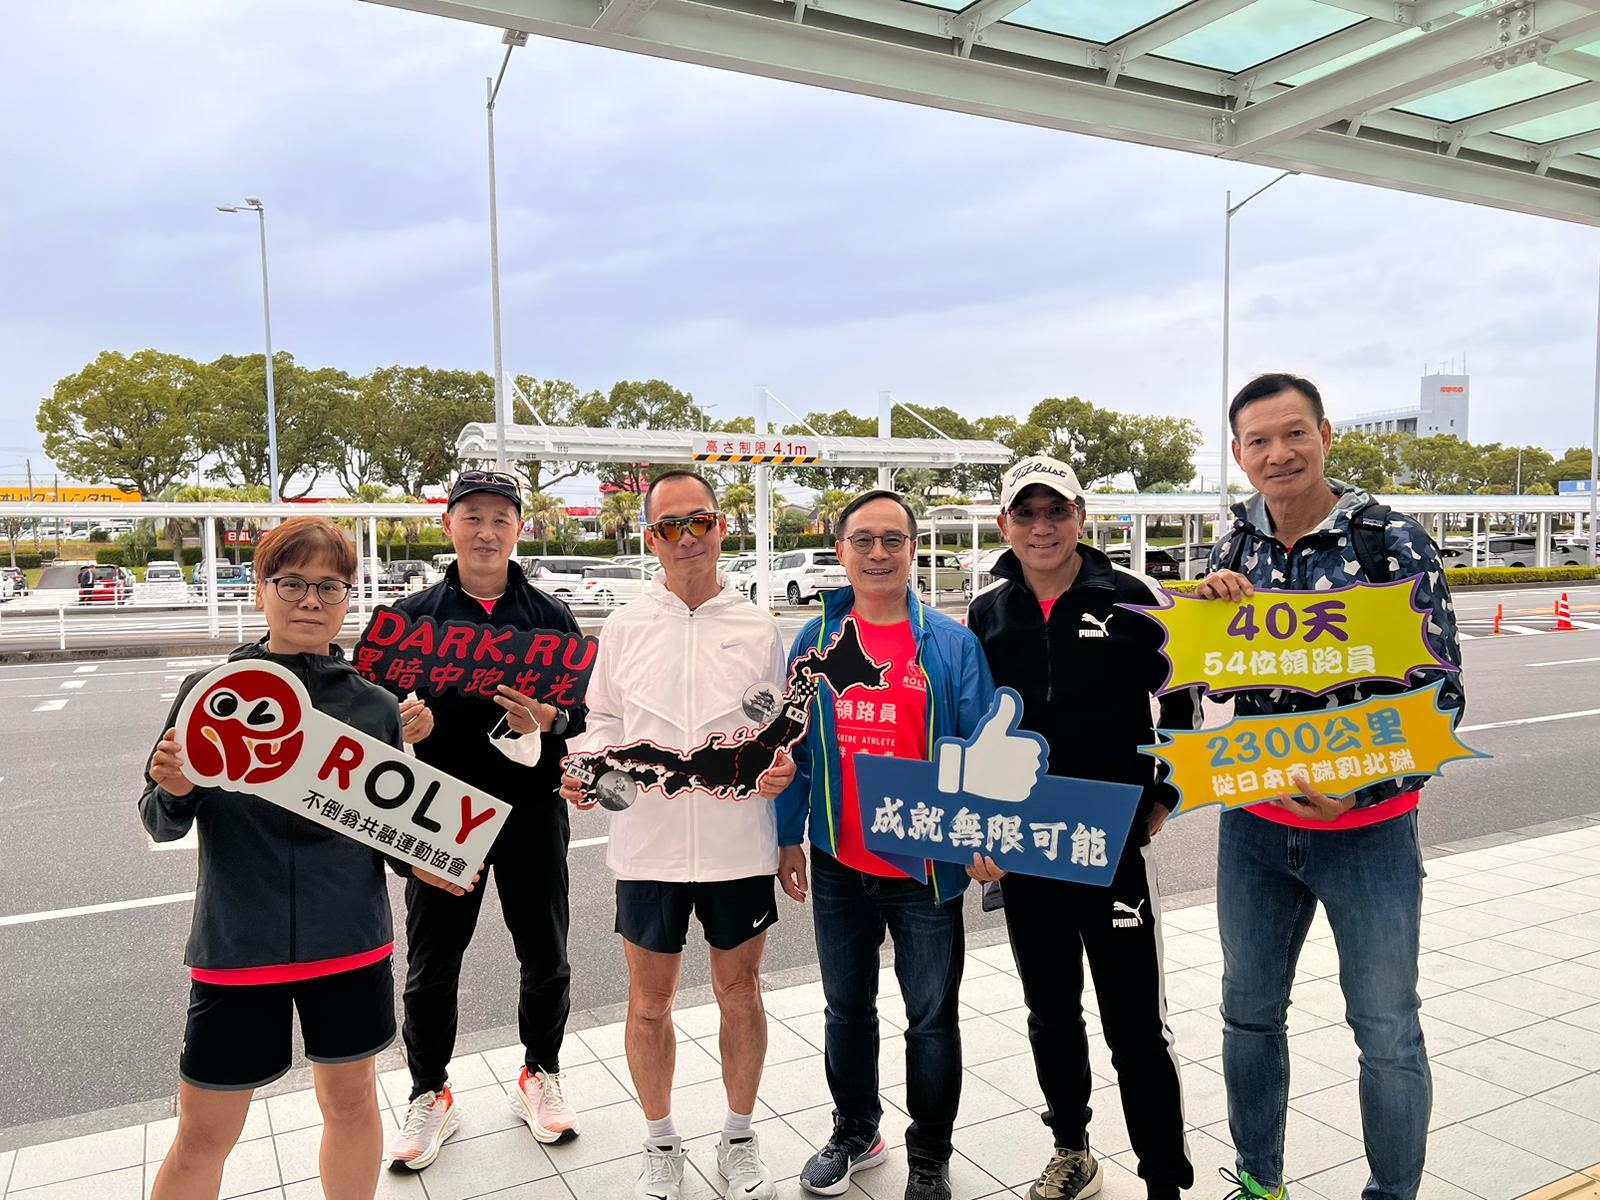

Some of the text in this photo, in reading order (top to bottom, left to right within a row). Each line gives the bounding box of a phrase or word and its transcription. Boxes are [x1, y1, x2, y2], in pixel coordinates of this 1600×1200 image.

[706, 440, 807, 455] 高さ制限 4.1m
[1009, 461, 1067, 487] Titleist
[1078, 629, 1104, 638] PUMA
[1227, 600, 1349, 643] 40天
[1203, 645, 1377, 676] 54位領跑員
[835, 699, 897, 724] 領路員
[861, 736, 897, 747] ATHLETE
[1206, 707, 1408, 768] 2300公里
[1211, 748, 1417, 797] 從日本南端到北端
[317, 735, 497, 845] ROLY
[302, 789, 468, 878] 不倒翁共融運動協會
[870, 797, 1109, 868] 成就無限可能
[1112, 918, 1139, 928] PUMA
